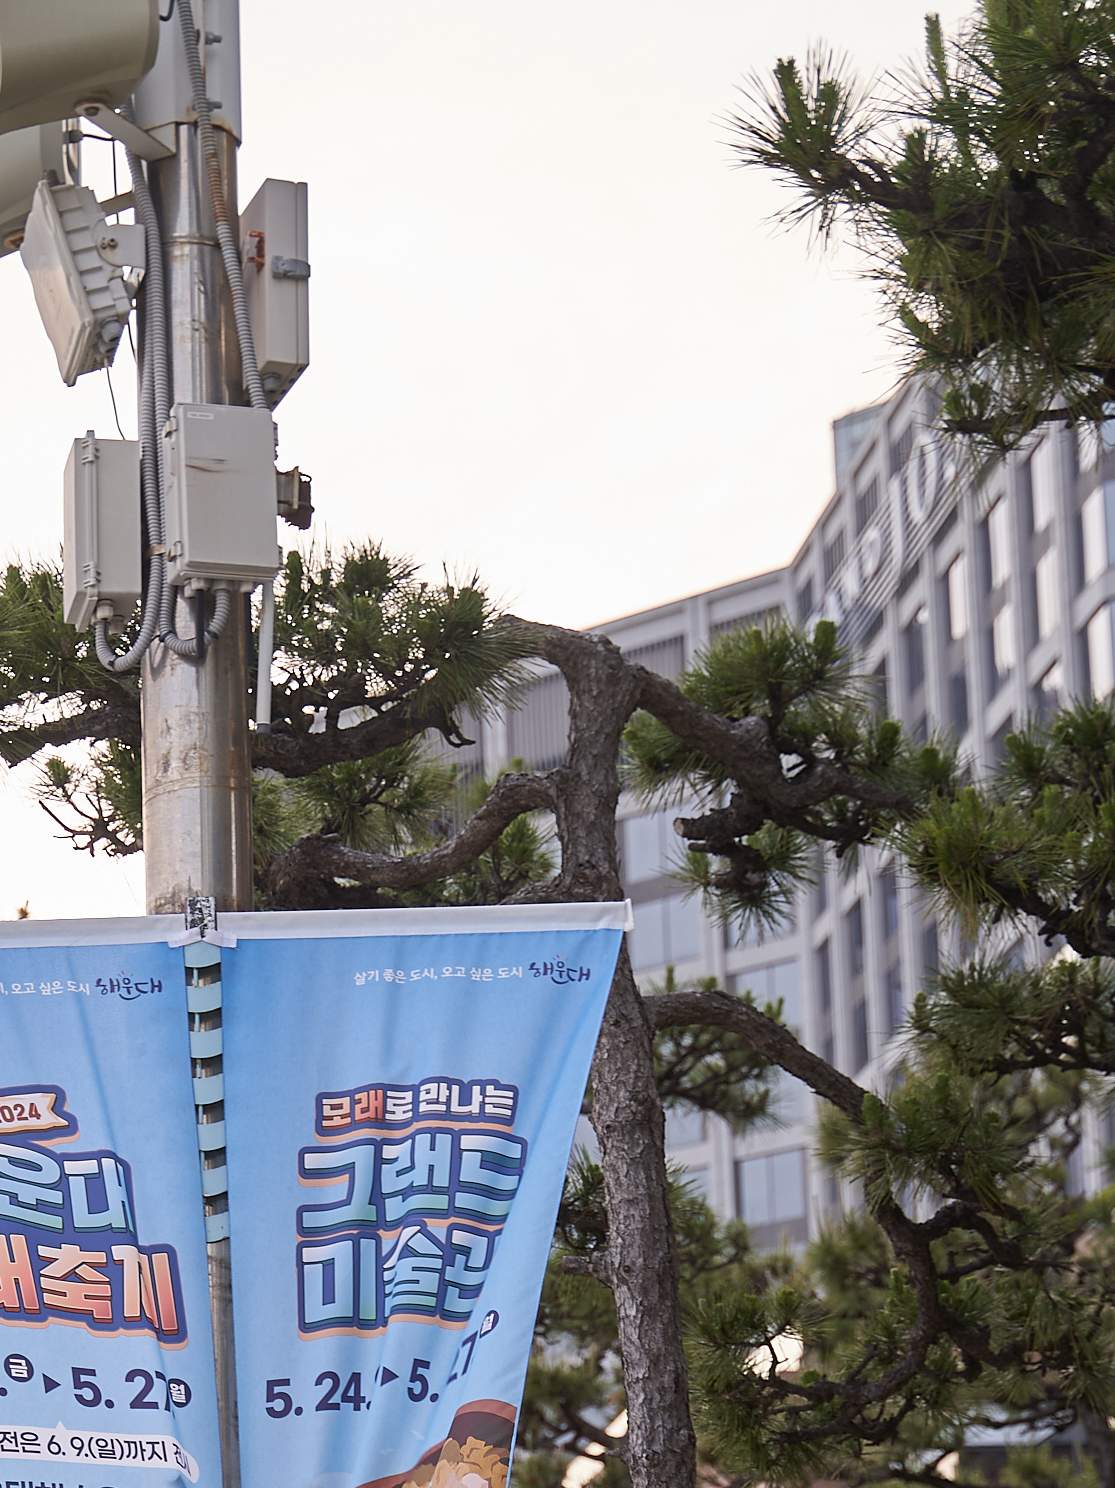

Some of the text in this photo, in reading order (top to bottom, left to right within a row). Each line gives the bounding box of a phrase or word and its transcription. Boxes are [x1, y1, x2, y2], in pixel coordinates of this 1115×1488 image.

[10, 982, 36, 995] 오고
[38, 981, 64, 996] 싶은
[67, 980, 90, 996] 도시
[94, 976, 164, 1001] 해운대
[354, 966, 524, 986] 살기 좋은 도시, 오고 싶은 도시
[528, 960, 592, 985] 해운대
[300, 1132, 524, 1232] 그랜드
[71, 1366, 116, 1410] 5.
[407, 1358, 439, 1403] 5.
[265, 1378, 304, 1419] 5.
